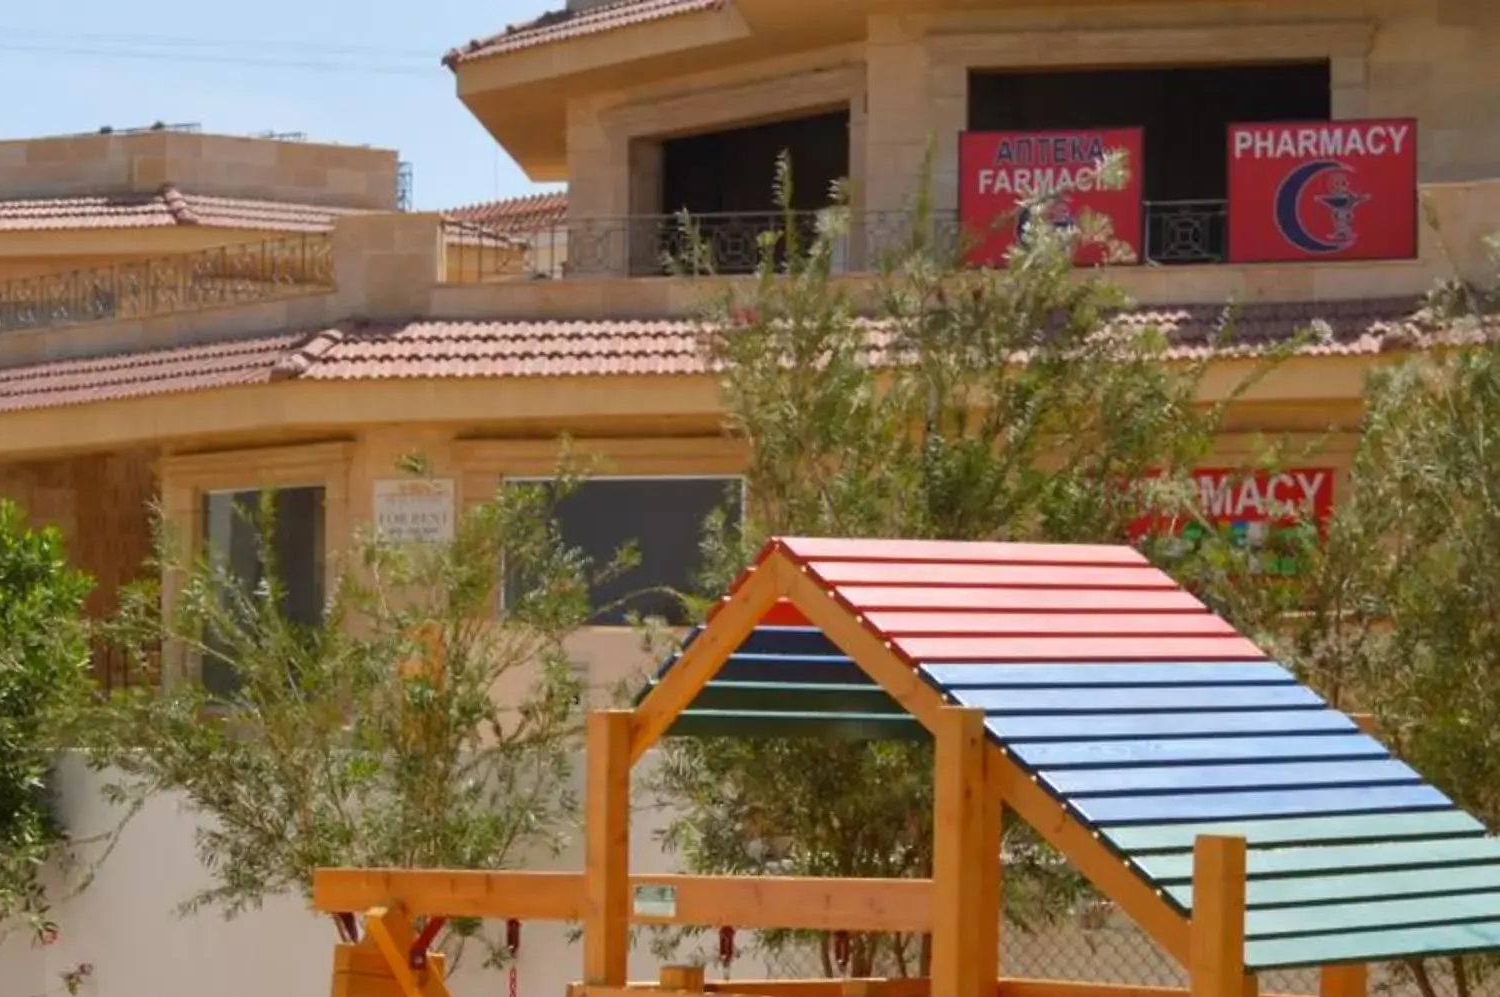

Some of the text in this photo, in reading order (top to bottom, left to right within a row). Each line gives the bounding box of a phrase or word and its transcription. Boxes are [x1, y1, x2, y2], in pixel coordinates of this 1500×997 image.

[1234, 125, 1409, 160] PHARMACY
[978, 167, 1120, 194] FARMACI
[1176, 473, 1327, 518] MACY
